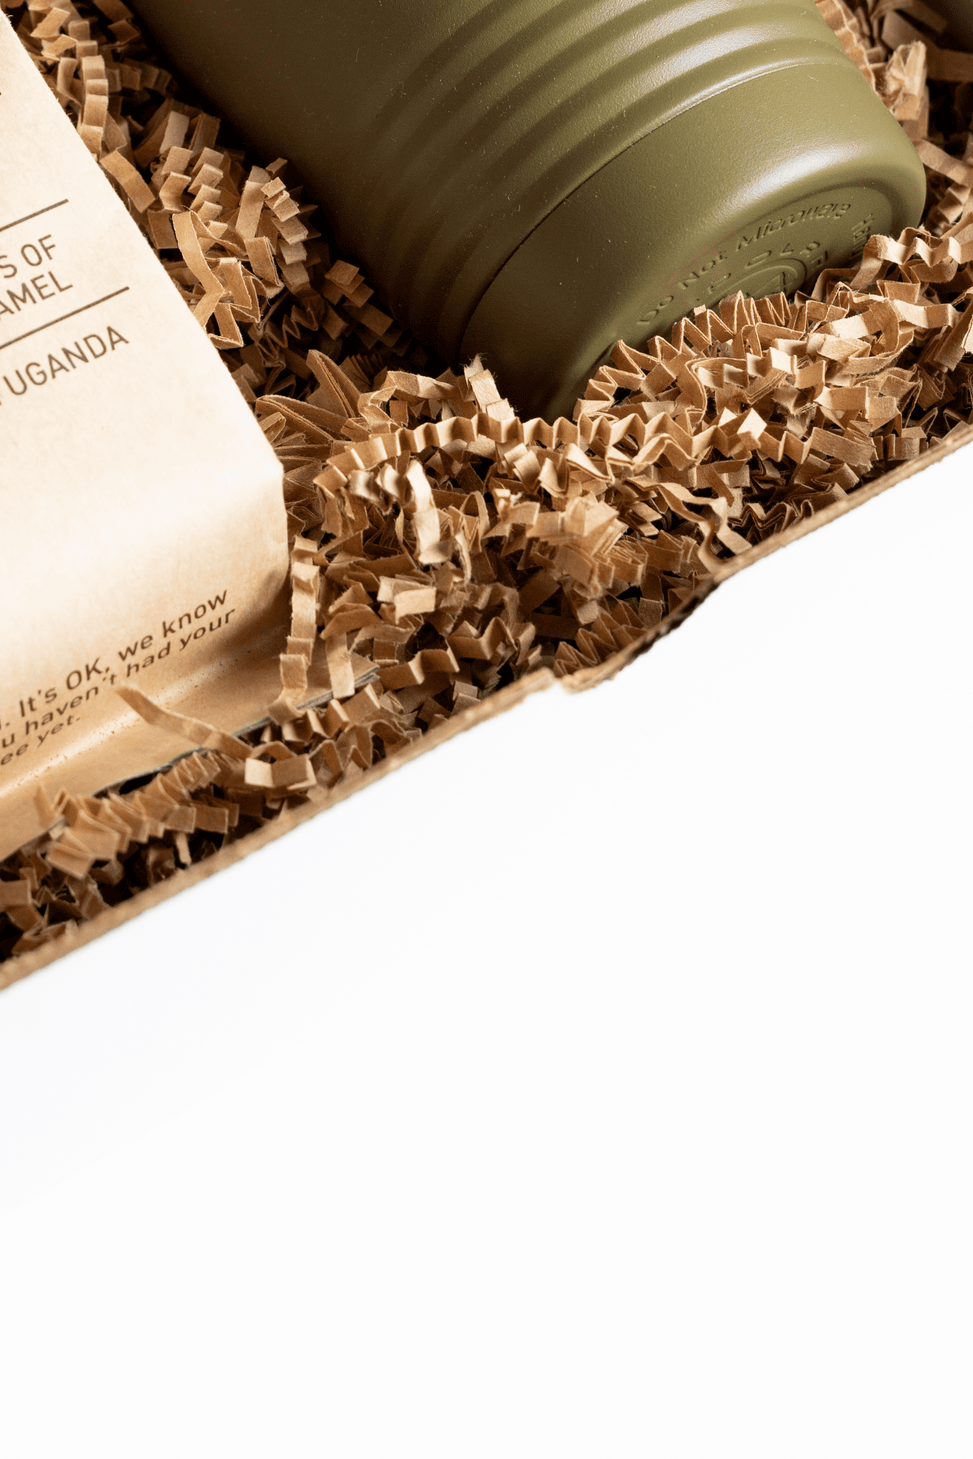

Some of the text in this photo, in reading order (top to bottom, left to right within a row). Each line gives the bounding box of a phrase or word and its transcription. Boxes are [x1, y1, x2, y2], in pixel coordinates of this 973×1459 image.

[19, 234, 59, 267] OF
[635, 294, 674, 325] Do
[679, 250, 727, 290] Not
[735, 202, 851, 252] Microwave
[2, 325, 130, 396] UGANDA
[18, 689, 58, 719] It's
[66, 658, 110, 691] OK,
[117, 633, 153, 662] we
[161, 588, 229, 638] know
[24, 672, 118, 736] haven't
[126, 644, 171, 678] had
[178, 609, 236, 650] your
[36, 714, 81, 747] yet.
